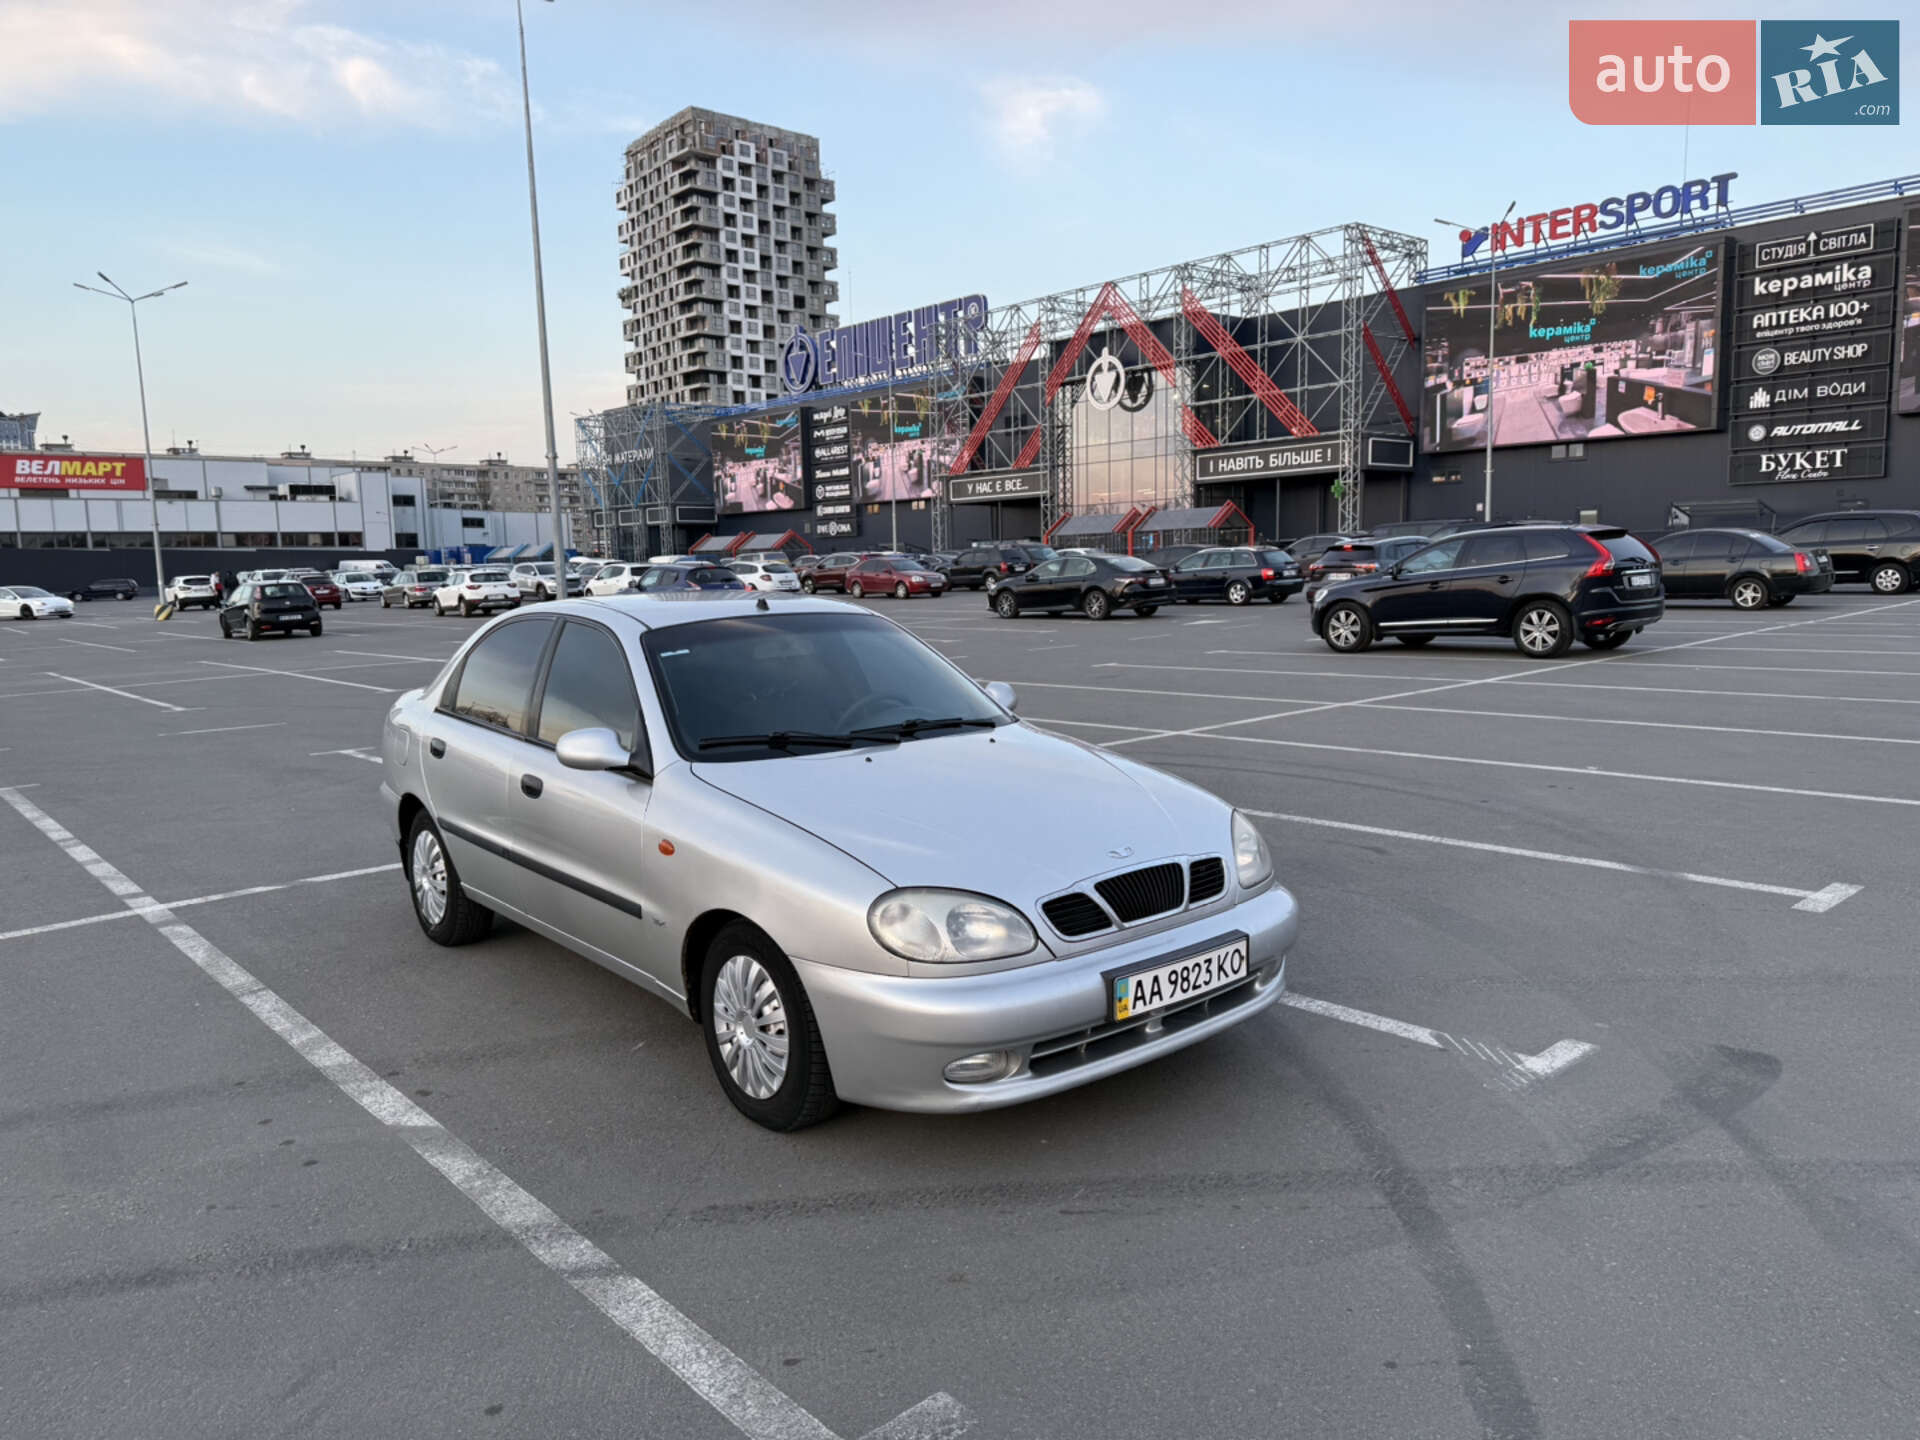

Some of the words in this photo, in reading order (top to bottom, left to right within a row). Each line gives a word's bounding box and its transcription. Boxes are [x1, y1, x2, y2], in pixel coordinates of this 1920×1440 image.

[1491, 172, 1738, 252] INTERSPORT
[1761, 242, 1806, 261] СТУДІЯ
[1819, 232, 1867, 252] СВІТЛА
[1833, 279, 1872, 292] центр
[1753, 305, 1825, 329] АПТЕКА
[1829, 300, 1871, 318] 100+
[1783, 348, 1832, 366] BEAUTY
[1833, 343, 1868, 360] SHOP
[1774, 387, 1809, 403] ДІМ
[1816, 381, 1867, 397] ВОДИ
[1770, 420, 1862, 437] AUTOMALL
[15, 459, 126, 477] ВЕЛМАРТ
[1218, 456, 1264, 472] НАВІТЬ
[1269, 449, 1322, 467] БІЛЬШЕ
[1760, 448, 1848, 472] БУКЕТ
[975, 481, 993, 494] НАС
[1132, 974, 1164, 1010] AA
[1168, 957, 1212, 998] 9823
[1217, 948, 1245, 981] KO
